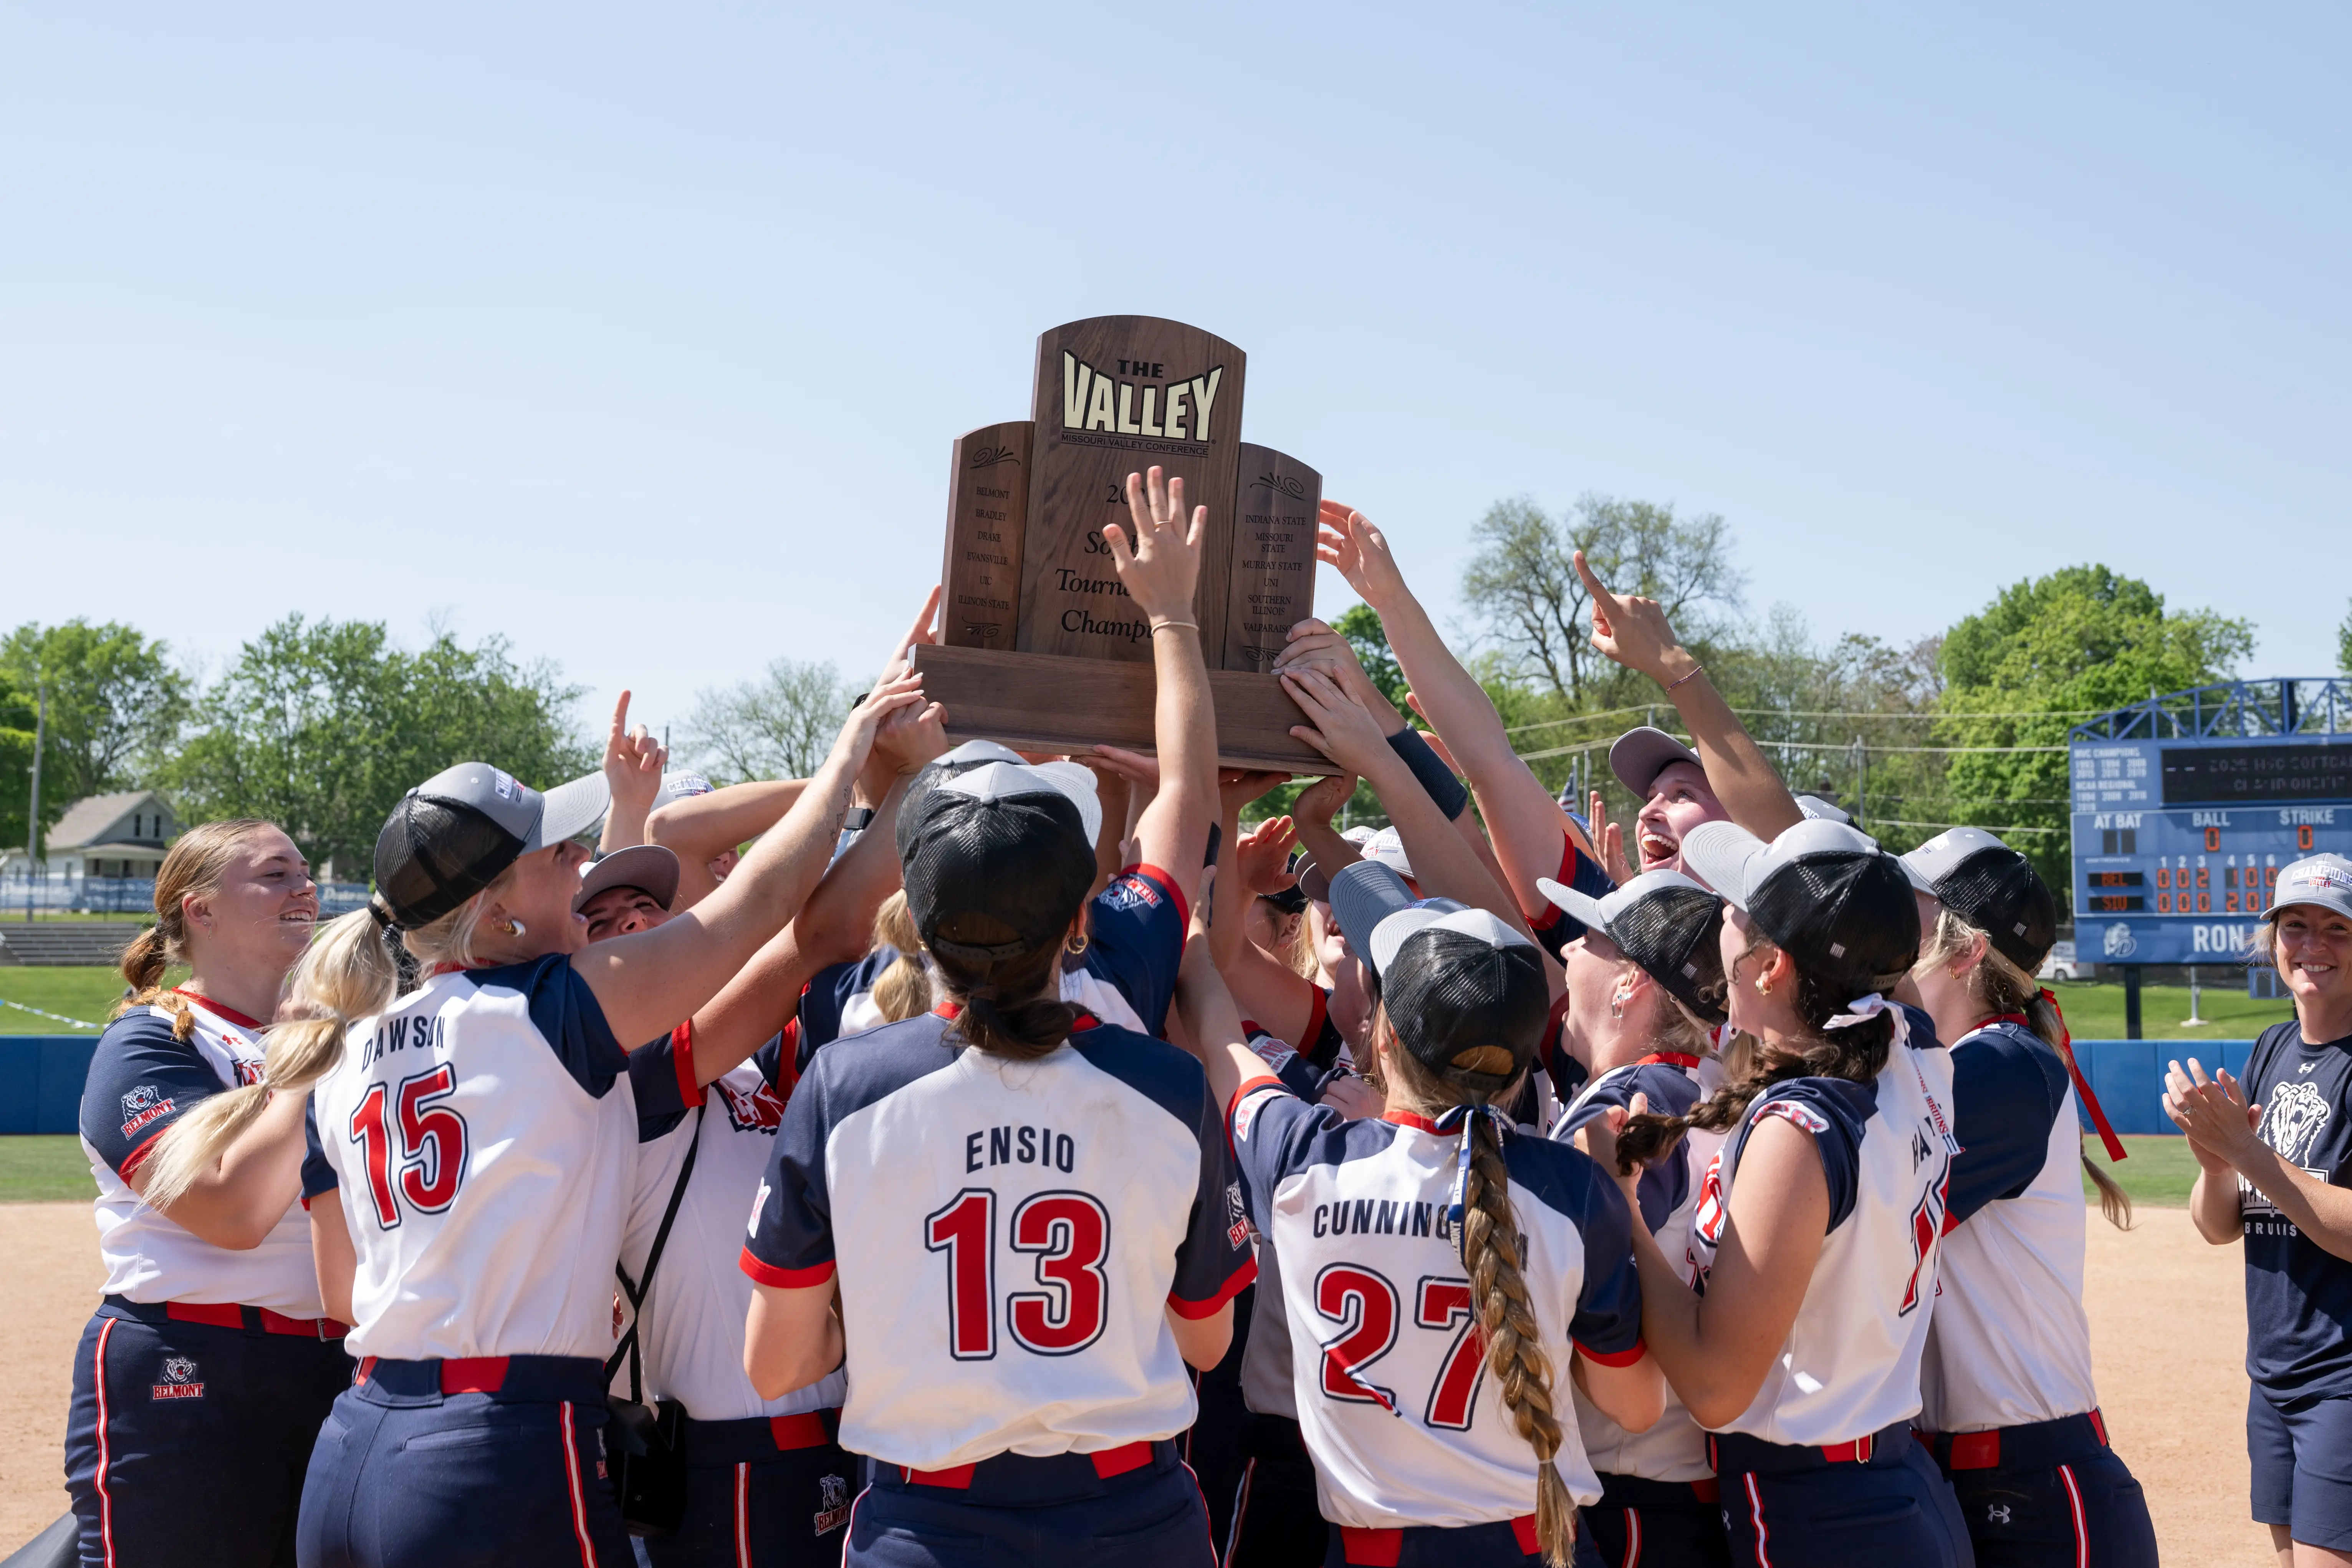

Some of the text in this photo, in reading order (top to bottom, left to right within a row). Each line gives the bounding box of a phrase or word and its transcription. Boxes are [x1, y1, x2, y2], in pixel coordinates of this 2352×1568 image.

[1117, 359, 1164, 378] THE
[1063, 349, 1224, 442] VALLEY
[1061, 434, 1208, 455] MISSOURI VALLEY CONFERENCE
[976, 486, 1010, 499] BELMONT
[975, 508, 1007, 521] BRADLEY
[1245, 515, 1306, 526] INDIANA STATE
[977, 531, 1001, 543] DRAKE
[1255, 532, 1293, 542] MISSOURI
[1261, 543, 1286, 553] STATE
[967, 551, 1008, 565] EVANSVILLE
[1242, 560, 1303, 571] MURRAY STATE
[980, 576, 993, 585] UIC
[1263, 578, 1279, 587] UNI
[958, 595, 1010, 610] ILLINOIS STATE
[1248, 594, 1291, 605] SOUTHERN
[1252, 606, 1285, 616] ILLINOIS
[1243, 623, 1292, 634] VALPARAISO
[2094, 813, 2143, 830] AT BAT
[2192, 811, 2231, 827] BALL
[2279, 808, 2335, 826] STRIKE
[2205, 827, 2220, 852] 0
[2297, 825, 2313, 850] 0
[2160, 856, 2167, 868] 1
[2178, 856, 2187, 868] 2
[2197, 855, 2206, 868] 3
[2227, 854, 2235, 866] 4
[2247, 854, 2256, 866] 5
[2266, 854, 2276, 866] 6
[2102, 871, 2129, 887] BEL
[2158, 867, 2278, 889] 0 0 2 1 0 0
[2291, 865, 2352, 885] CHAMPIONS
[2309, 877, 2332, 888] VALLEY
[2102, 896, 2127, 911] SIU
[2158, 893, 2171, 912] 0
[2178, 892, 2191, 912] 0
[2197, 892, 2210, 912] 0
[2226, 892, 2239, 912] 2
[2246, 892, 2259, 912] 0
[2193, 925, 2245, 953] RON
[361, 1015, 445, 1075] DAWSON
[122, 1099, 175, 1138] BELMONT
[1925, 1097, 1950, 1134] BRUINS
[349, 1061, 468, 1231] 15
[967, 1125, 1074, 1174] ENSIO
[1942, 1133, 1958, 1153] 11
[925, 1187, 1111, 1361] 13
[1314, 1262, 1495, 1432] 27
[153, 1383, 204, 1400] BELMONT
